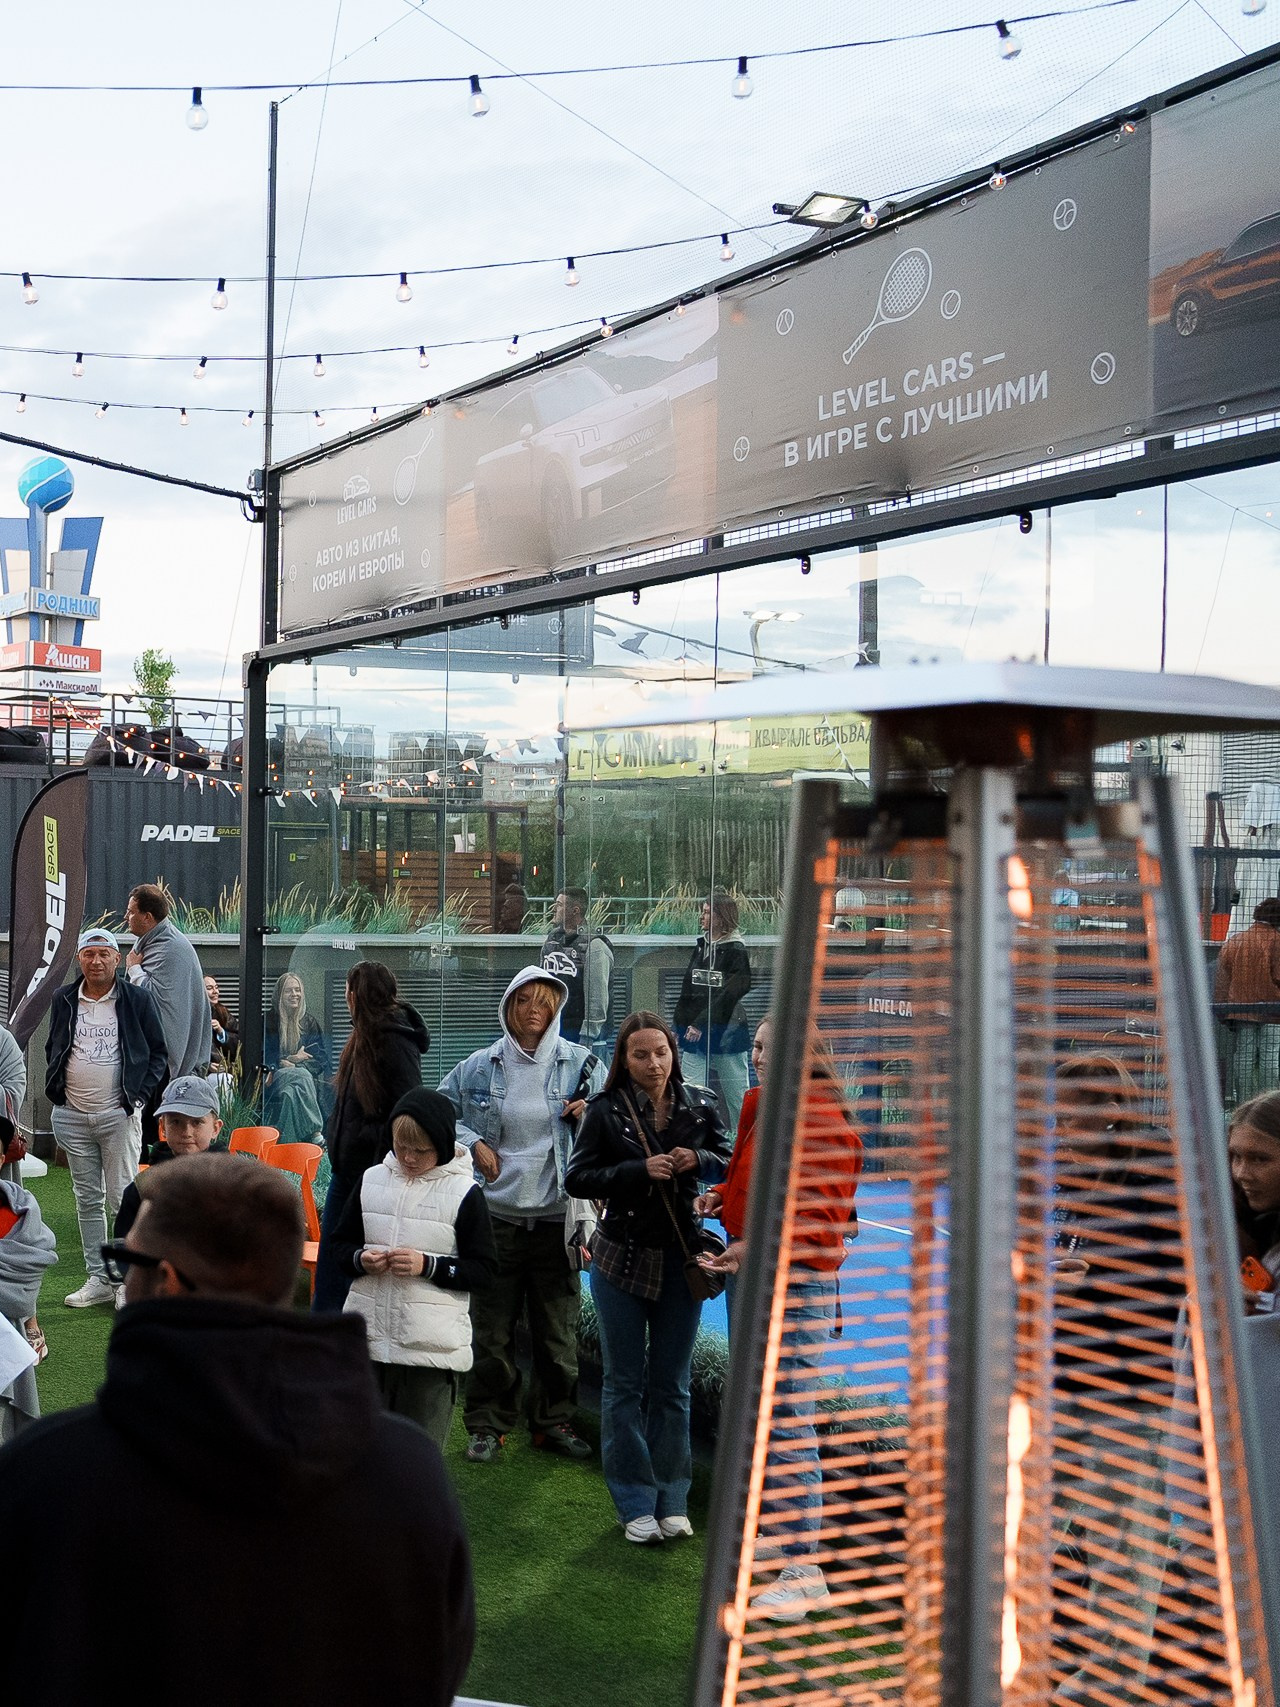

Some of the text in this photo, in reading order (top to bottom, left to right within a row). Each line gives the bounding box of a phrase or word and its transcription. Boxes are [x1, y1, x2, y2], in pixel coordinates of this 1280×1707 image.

[817, 377, 896, 421] LEVEL
[902, 351, 974, 396] CARS
[784, 370, 1049, 467] В ИГРЕ С ЛУЧШИМИ
[337, 496, 377, 526] LEVEL CARS
[315, 525, 401, 568] АВТО ИЗ КИТАЯ,
[312, 550, 405, 593] КОРЕИ И ЕВРОПЫ
[36, 591, 98, 617] РОДНИК
[55, 740, 91, 748] RENZ-VOUS
[754, 728, 811, 748] КВАРТАЛЕ
[140, 825, 220, 842] PADEL
[9, 821, 67, 1025] ADEL SPACE
[868, 997, 913, 1018] LEVEL CA
